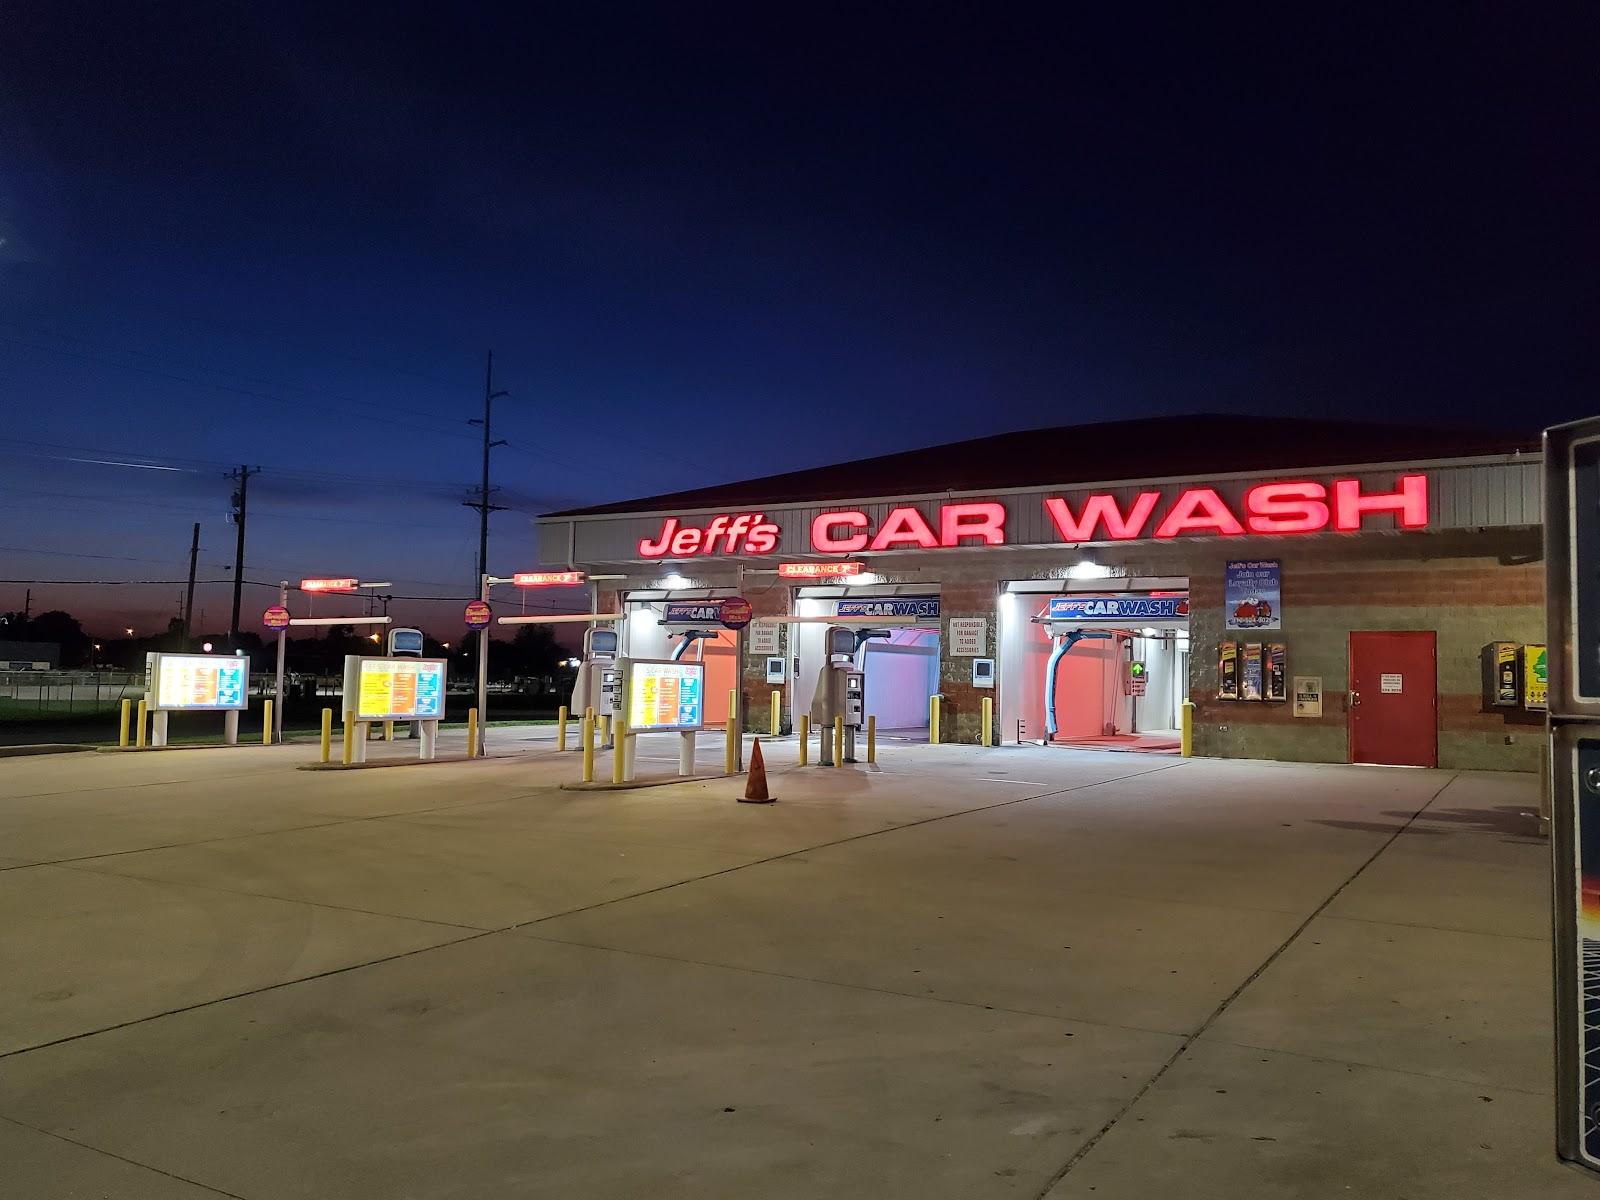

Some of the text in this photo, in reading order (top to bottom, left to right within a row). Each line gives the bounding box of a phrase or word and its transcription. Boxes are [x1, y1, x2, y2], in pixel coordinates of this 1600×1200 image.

[639, 474, 1428, 557] Jeff's CAR WASH
[786, 565, 839, 573] CLEARANCE
